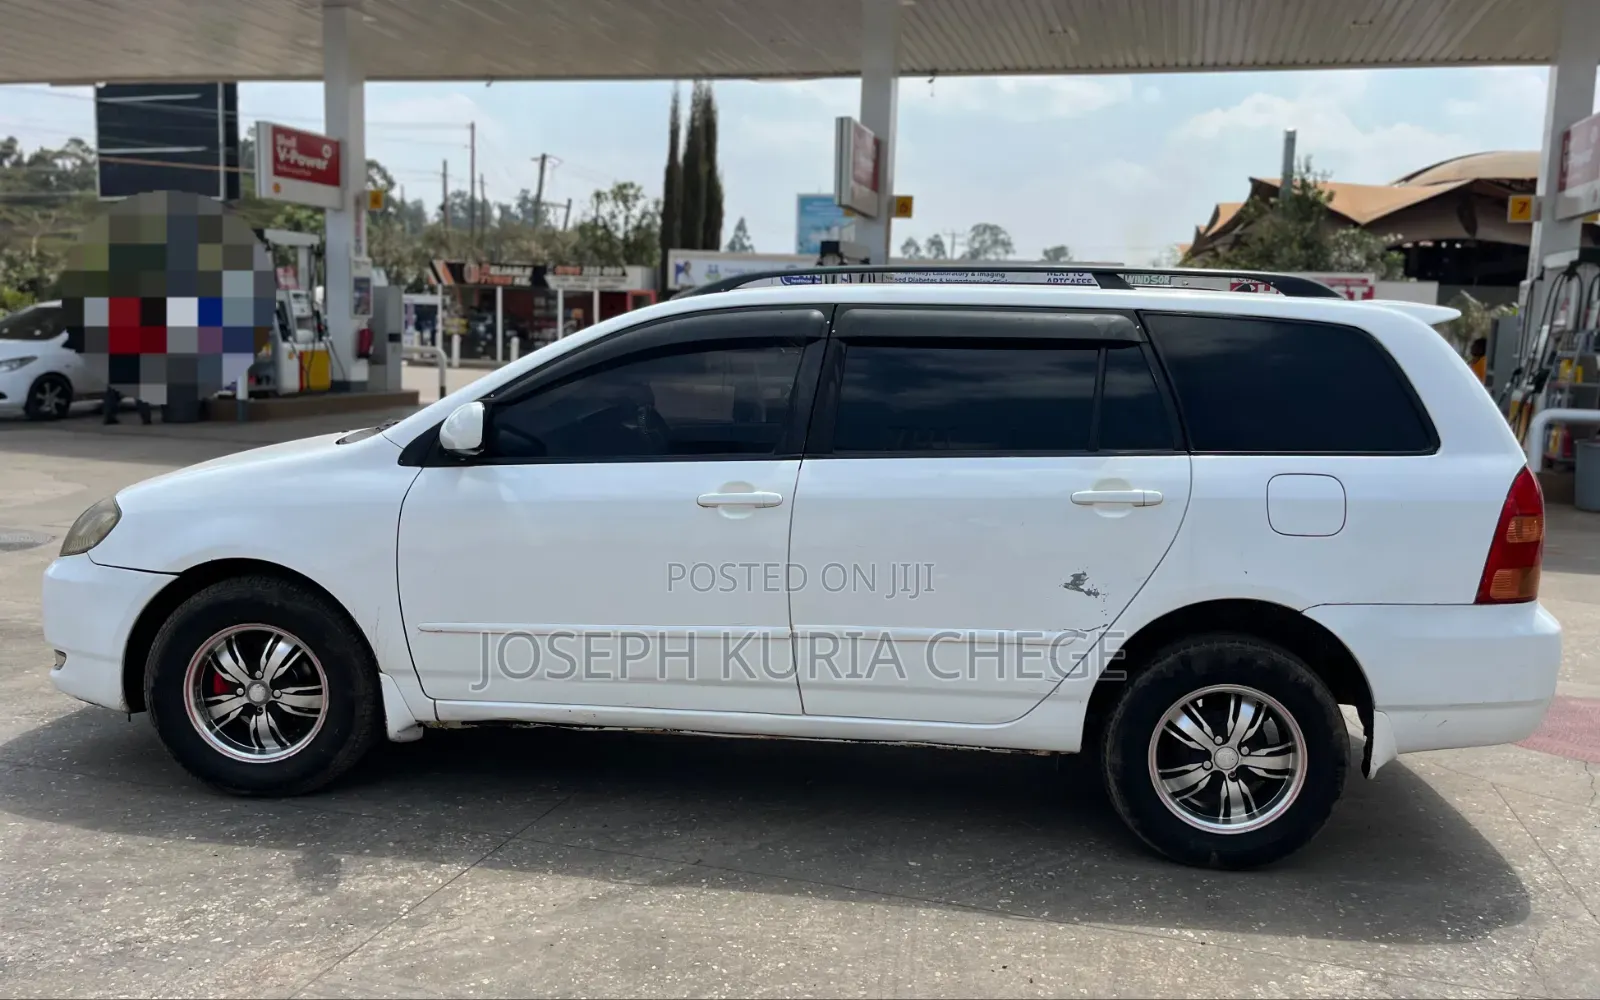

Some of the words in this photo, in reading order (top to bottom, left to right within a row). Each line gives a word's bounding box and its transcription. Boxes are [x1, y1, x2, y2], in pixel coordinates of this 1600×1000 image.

[276, 145, 329, 171] V-Power
[1517, 201, 1528, 214] 7
[1125, 274, 1171, 285] WINDSOR
